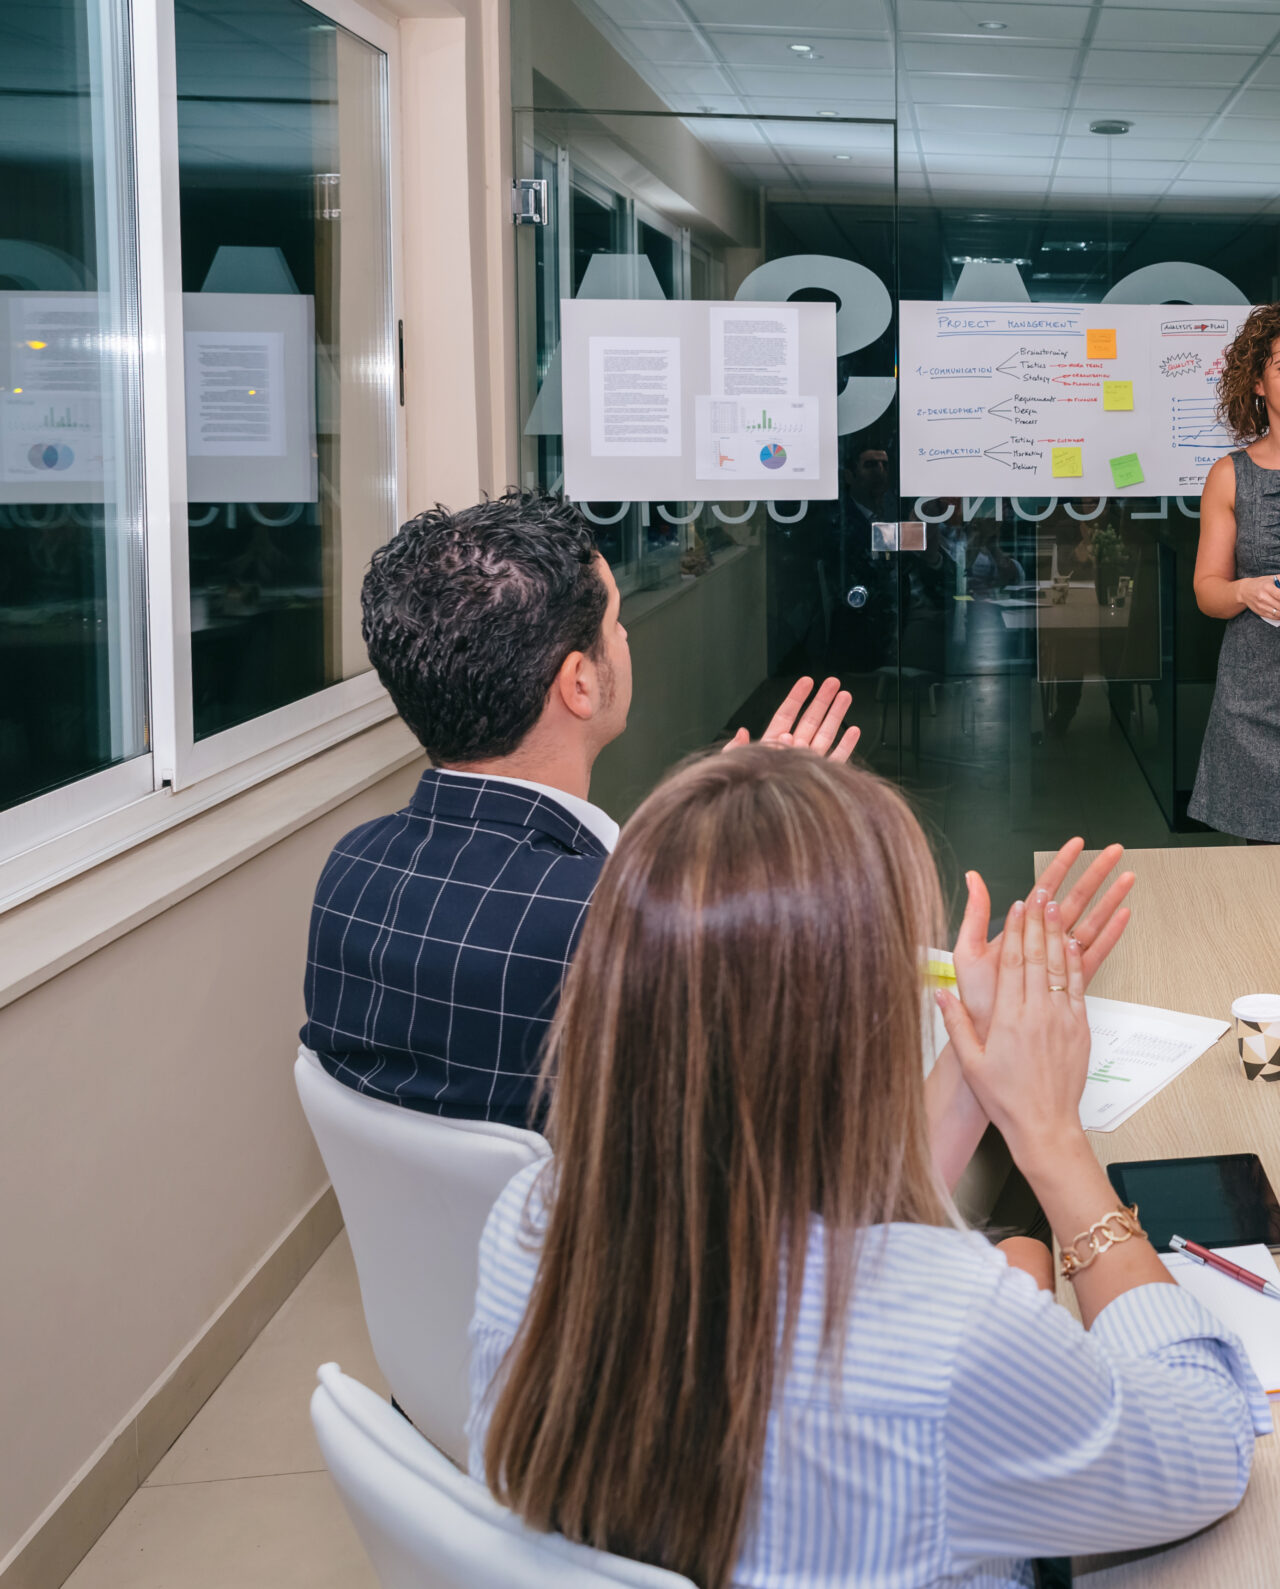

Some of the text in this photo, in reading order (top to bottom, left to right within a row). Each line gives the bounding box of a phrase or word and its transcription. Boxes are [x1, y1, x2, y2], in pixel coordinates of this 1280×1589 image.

[938, 316, 1078, 329] PROJECT MANAGEMENT
[1020, 347, 1069, 359] Brainstorming
[1167, 359, 1195, 372] QUALITY
[929, 447, 981, 457] COMPLETION
